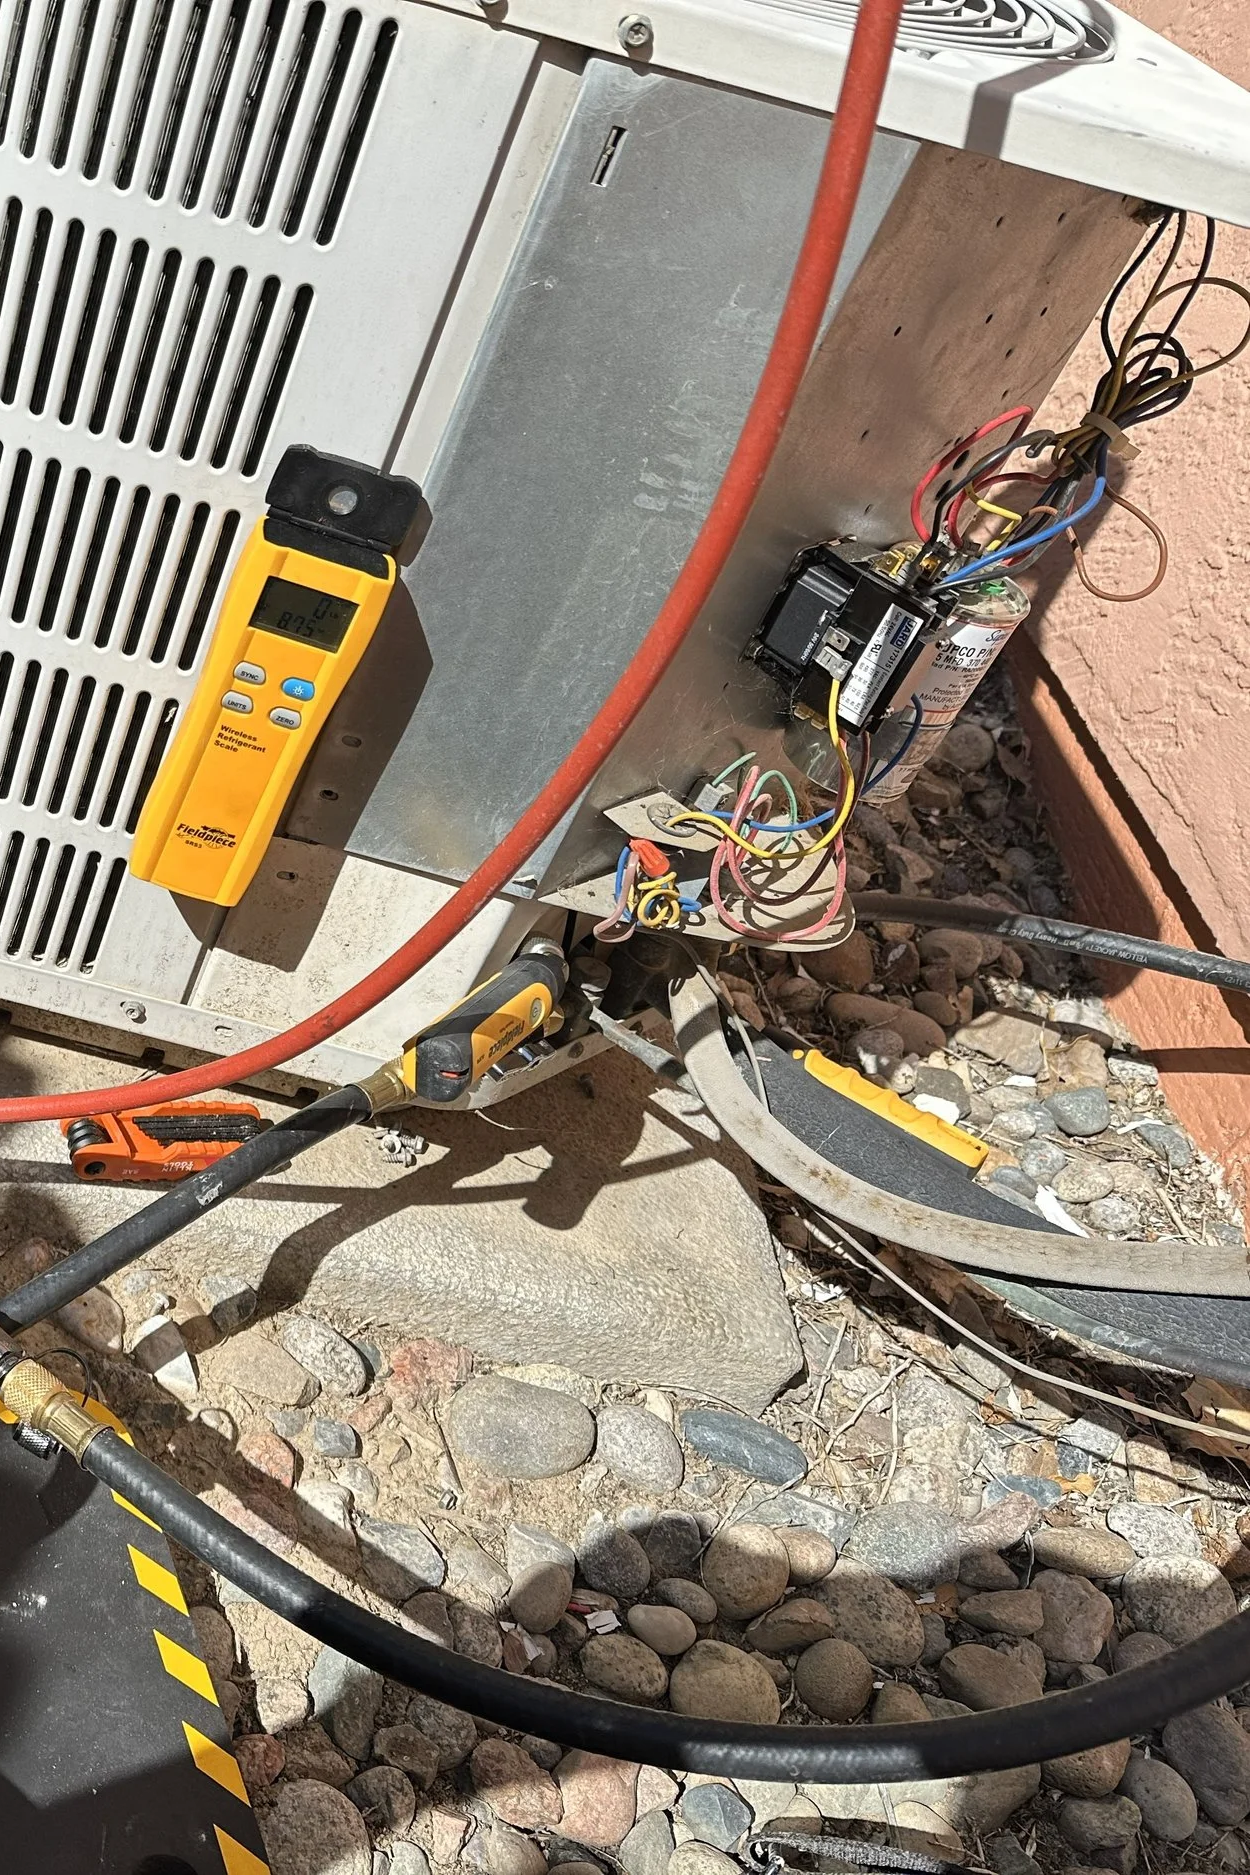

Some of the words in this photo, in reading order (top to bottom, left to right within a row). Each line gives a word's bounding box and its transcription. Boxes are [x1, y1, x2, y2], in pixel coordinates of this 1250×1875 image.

[893, 619, 915, 648] JARD
[941, 643, 975, 658] UPCO
[884, 648, 900, 669] 17315
[239, 670, 259, 680] SYNC
[227, 699, 247, 710] UNITS
[275, 716, 295, 727] ZERO
[220, 724, 257, 742] Wireless
[213, 739, 238, 753] Scale
[217, 732, 265, 753] Refrigerant
[176, 822, 236, 848] Fieldpiece
[1017, 927, 1034, 939] Duty
[1034, 931, 1057, 943] Heavy
[1118, 950, 1147, 963] YELLOW
